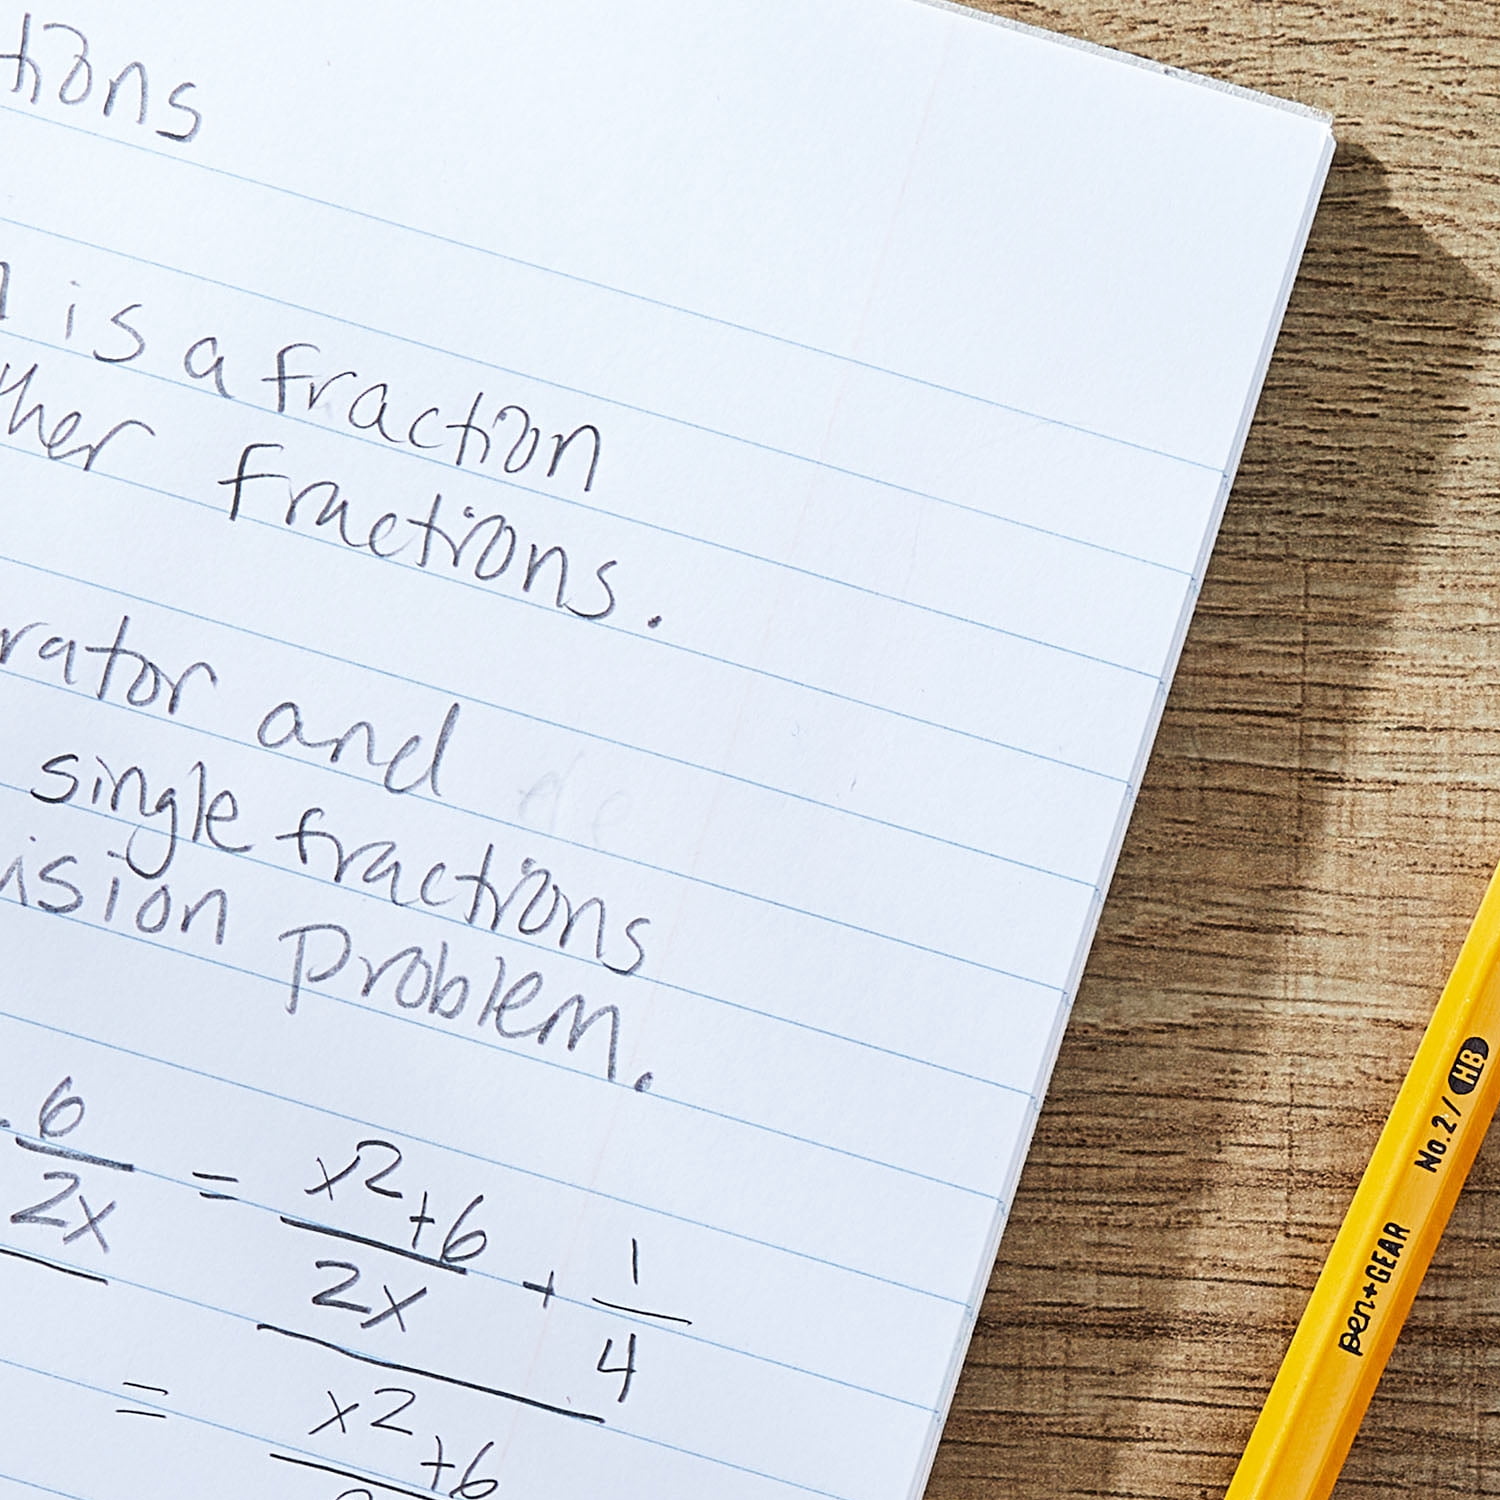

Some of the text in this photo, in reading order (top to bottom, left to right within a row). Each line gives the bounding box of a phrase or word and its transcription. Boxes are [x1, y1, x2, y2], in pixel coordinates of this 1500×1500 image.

[65, 280, 146, 363] is
[184, 336, 236, 400] a
[262, 343, 602, 491] fraction
[218, 443, 662, 629] fractions.
[257, 702, 460, 797] and
[30, 753, 651, 976] single fractions
[1450, 1045, 1488, 1088] HB
